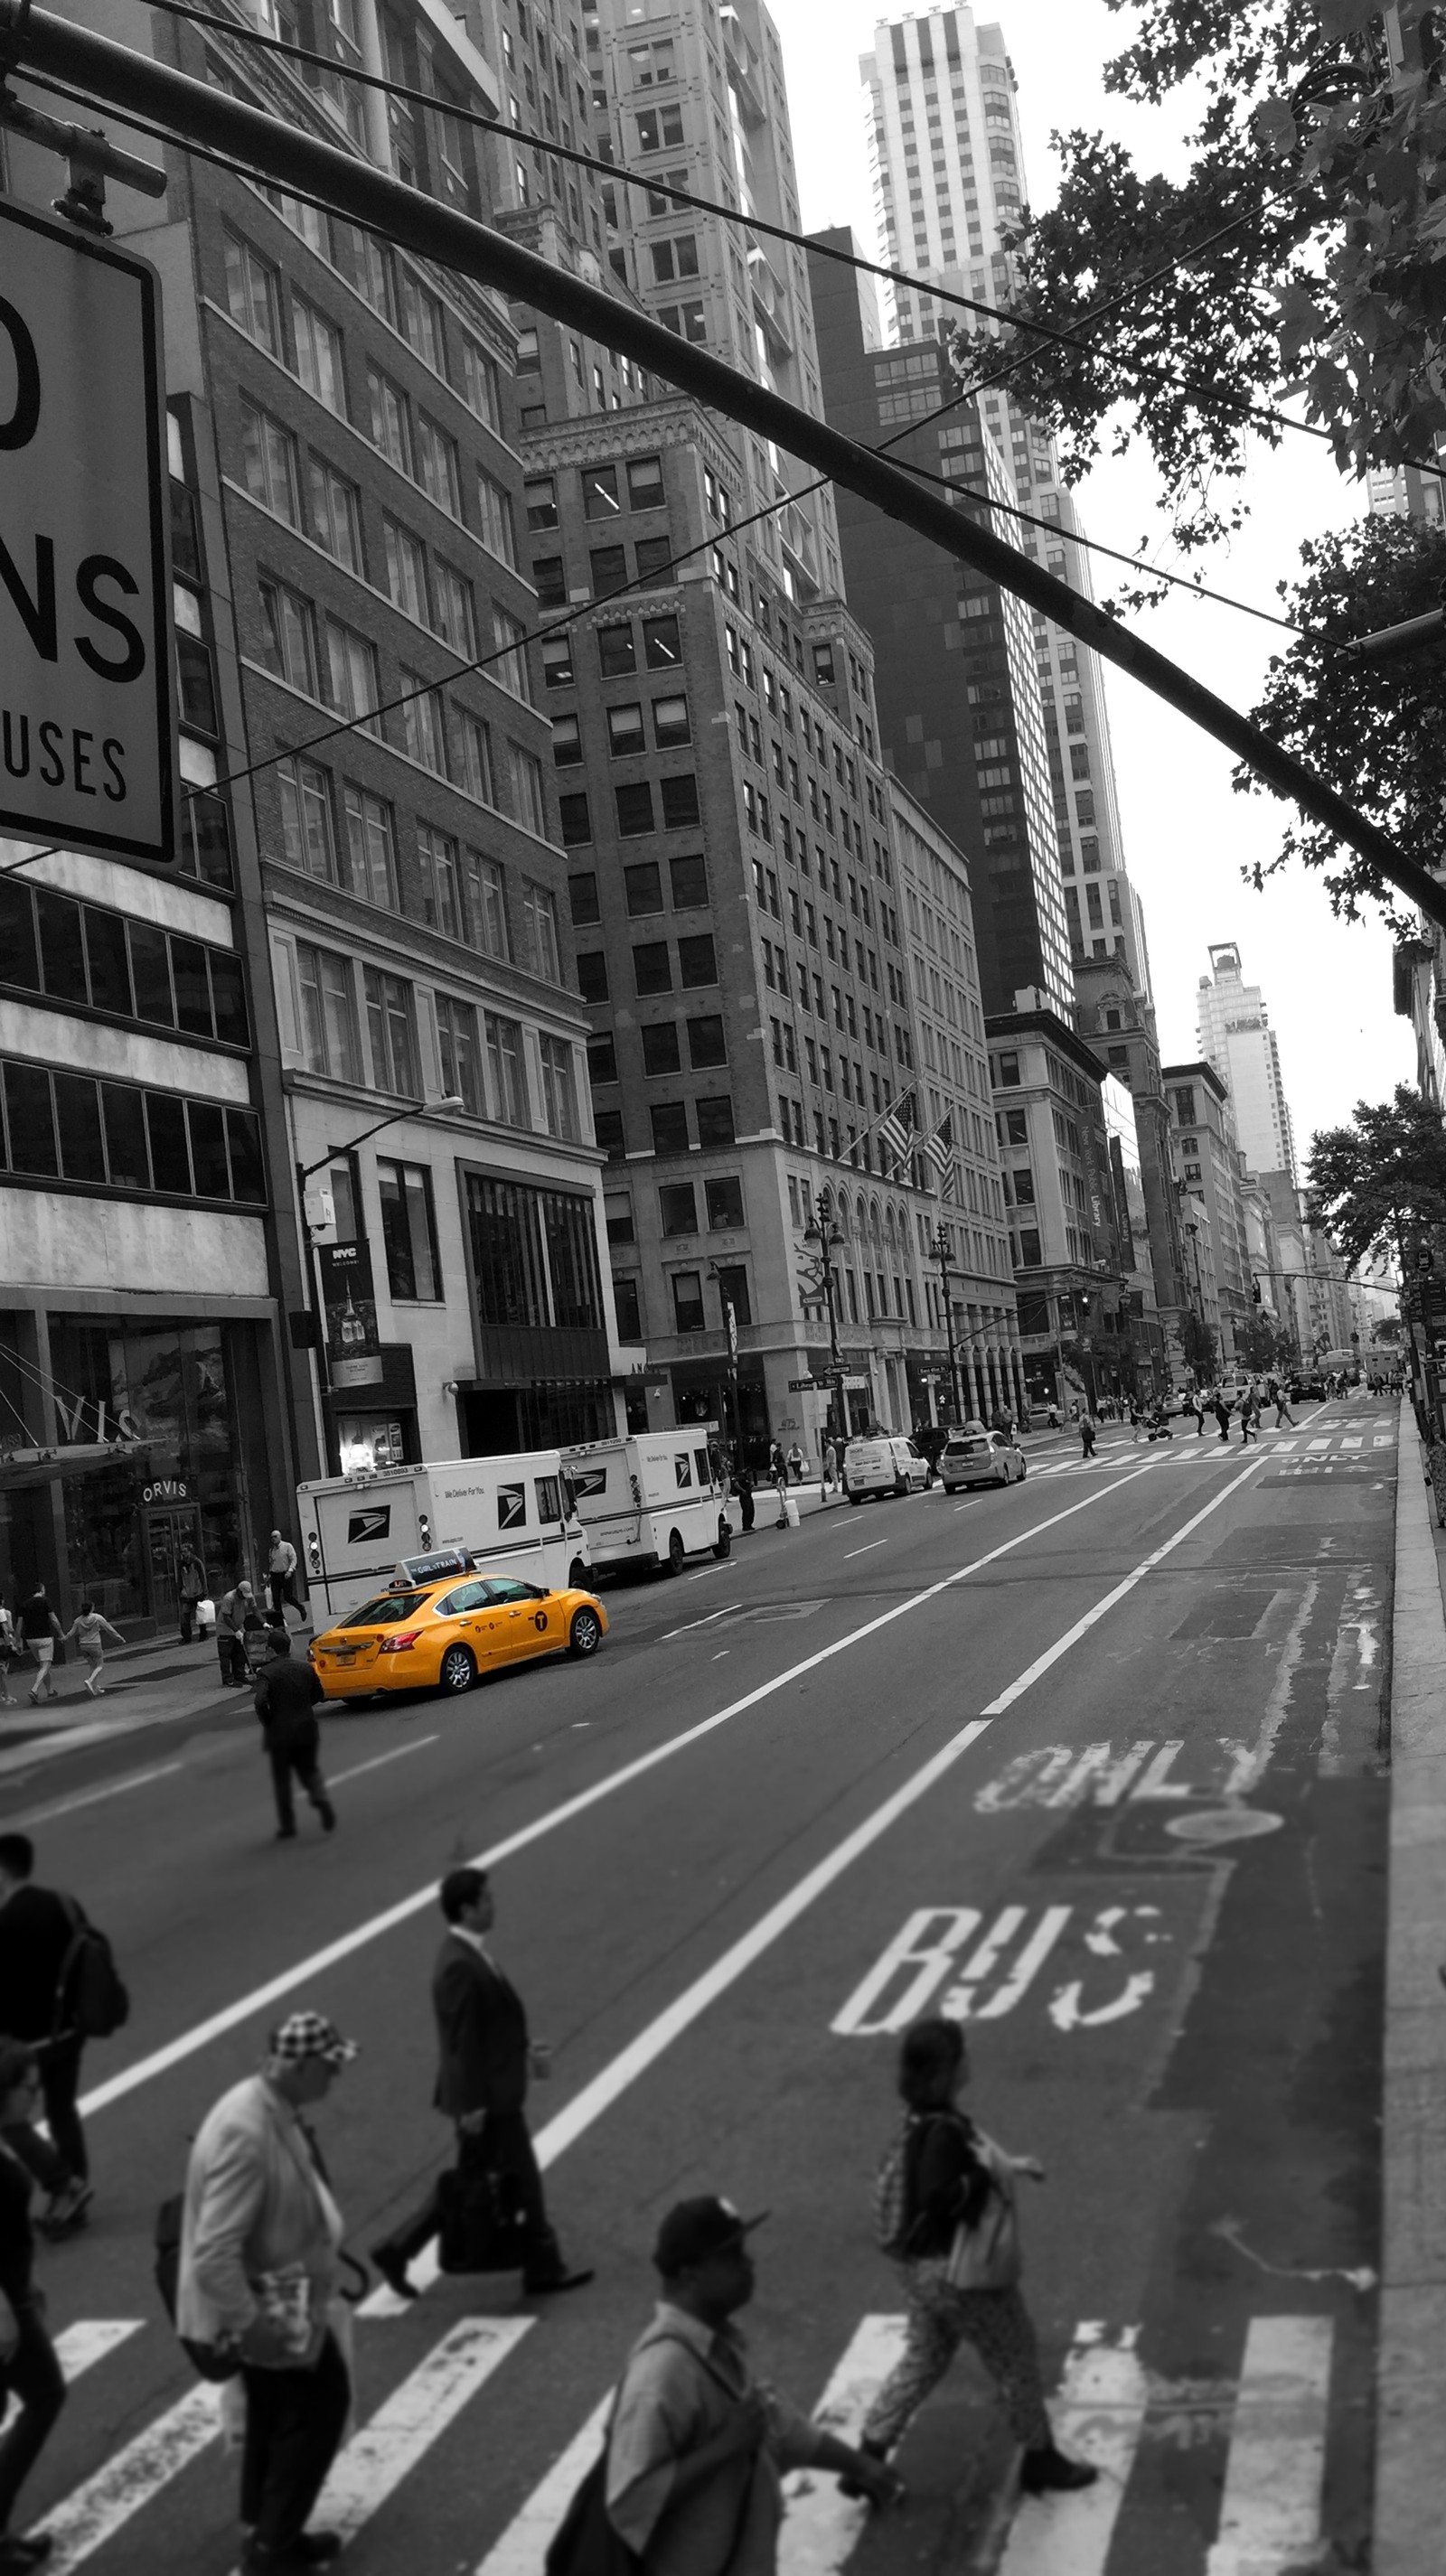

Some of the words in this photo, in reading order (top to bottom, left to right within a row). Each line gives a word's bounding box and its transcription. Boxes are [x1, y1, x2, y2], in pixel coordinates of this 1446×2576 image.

[1091, 1194, 1102, 1227] Library
[332, 1247, 357, 1260] NYC
[1281, 1453, 1369, 1464] ONLY
[143, 1480, 187, 1502] ORVIS
[418, 1565, 434, 1574] GIRL
[436, 1558, 457, 1570] TRAIN
[974, 1738, 1265, 1813] ONLY
[829, 1906, 1174, 2033] BUS
